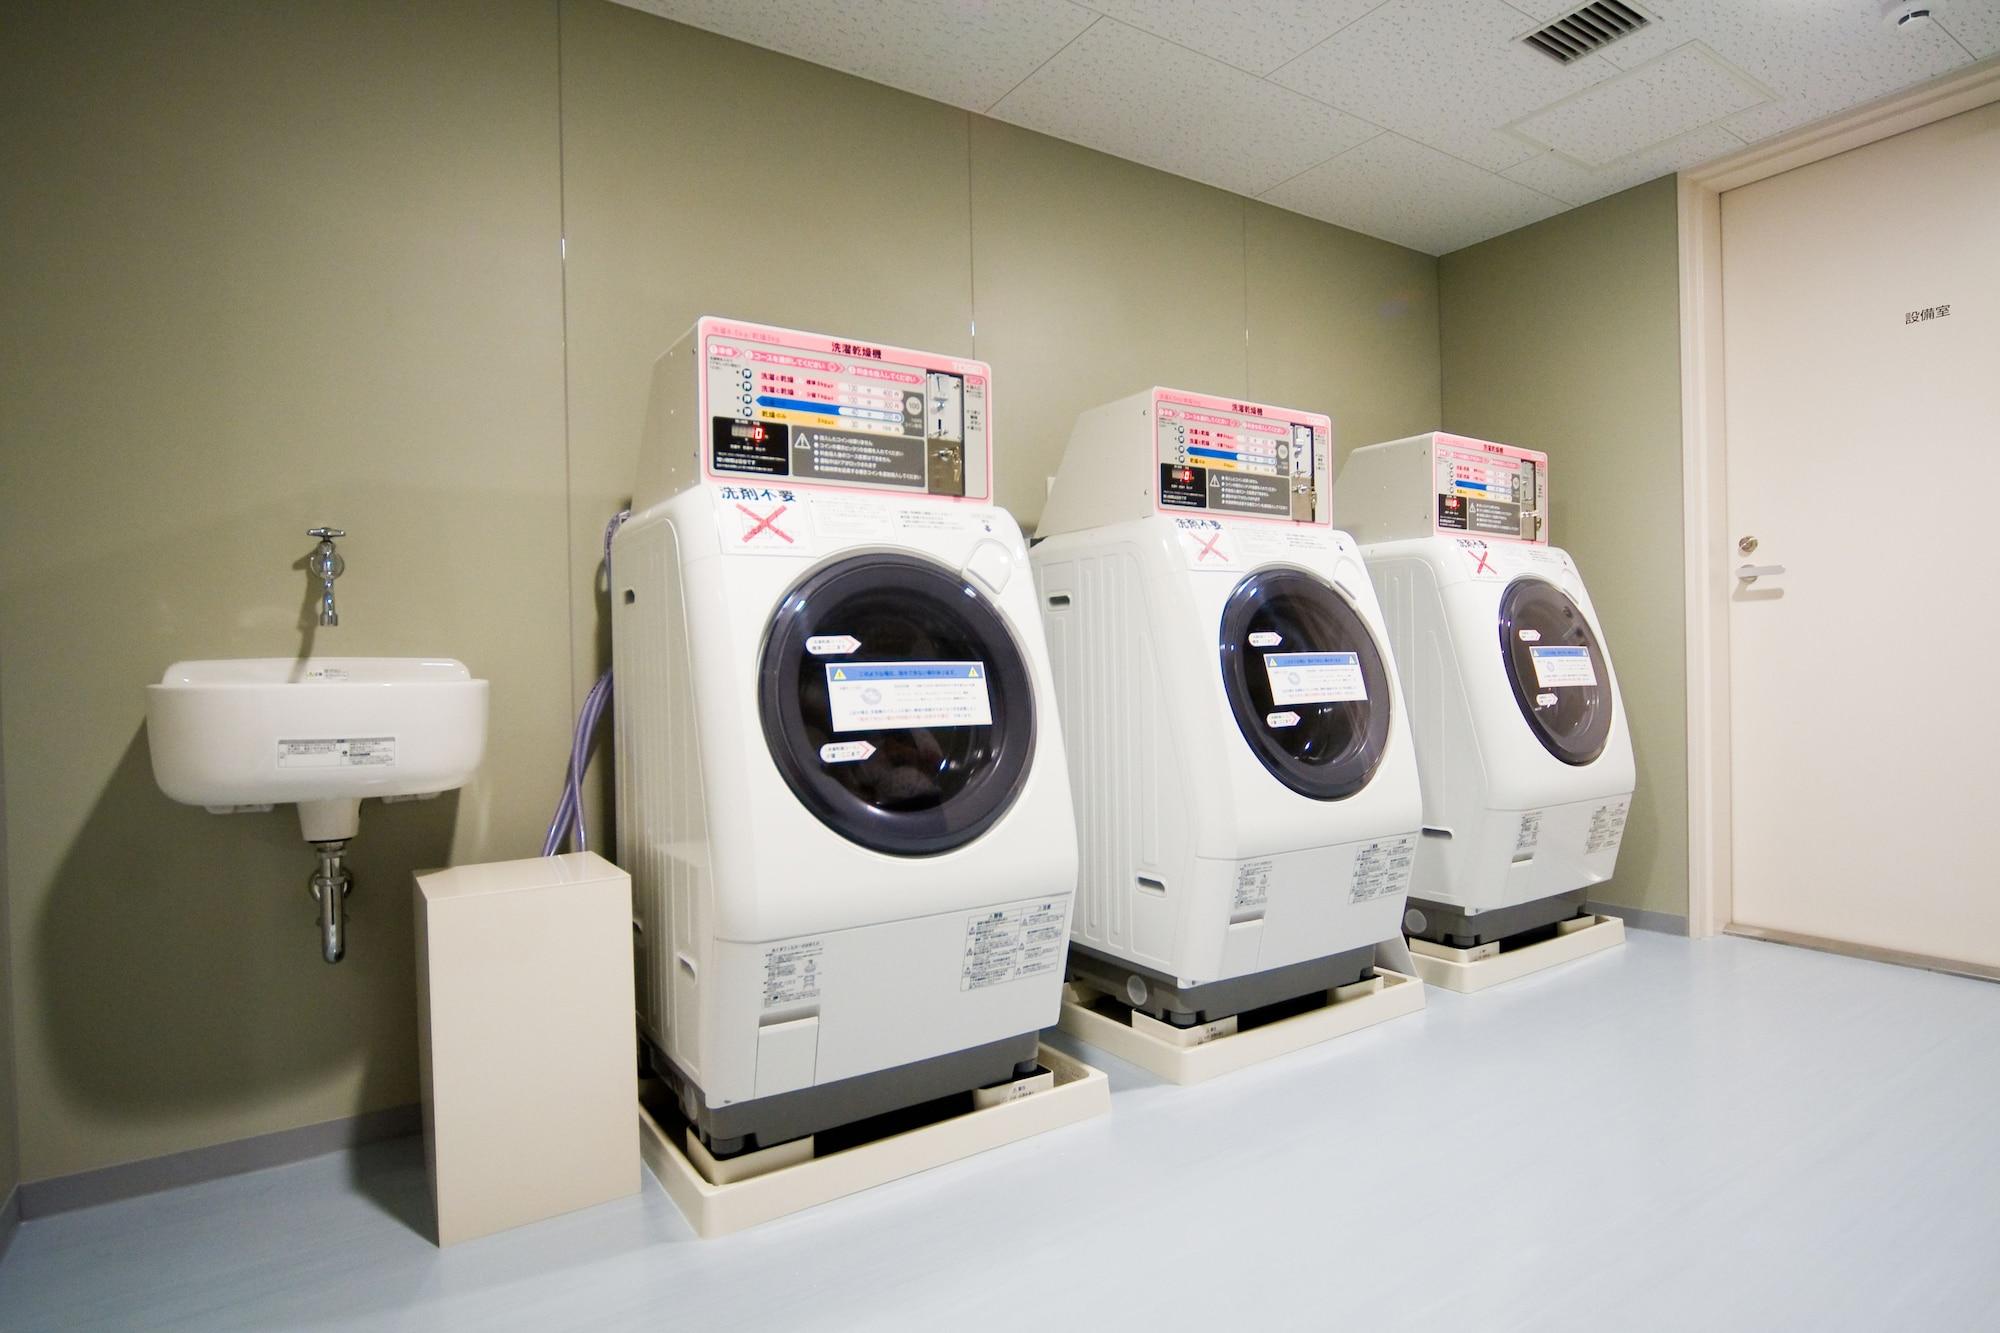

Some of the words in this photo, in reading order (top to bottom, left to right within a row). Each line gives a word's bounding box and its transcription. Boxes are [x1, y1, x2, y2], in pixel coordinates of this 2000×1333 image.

[1905, 304, 1951, 325] 設備室
[832, 341, 882, 359] 洗濯乾燥機
[721, 486, 796, 503] 洗剤不要
